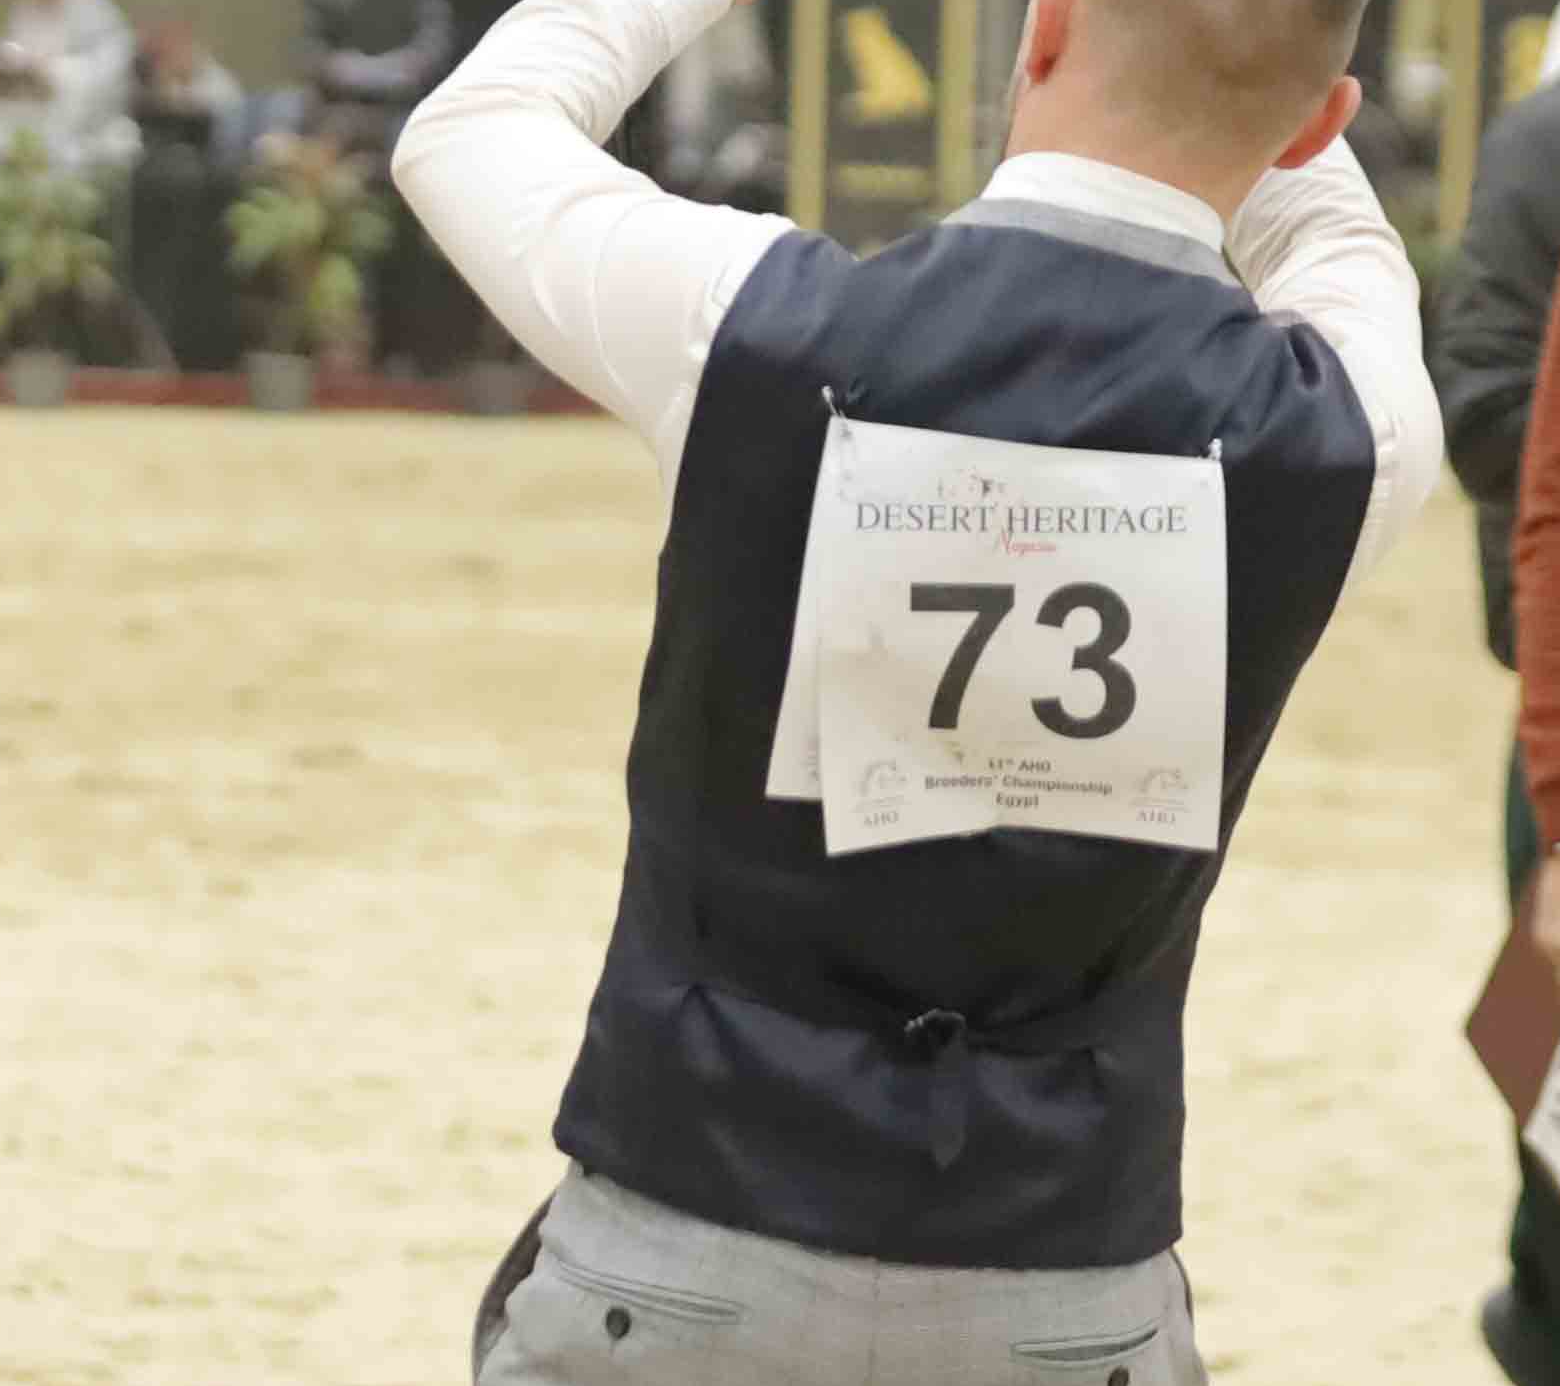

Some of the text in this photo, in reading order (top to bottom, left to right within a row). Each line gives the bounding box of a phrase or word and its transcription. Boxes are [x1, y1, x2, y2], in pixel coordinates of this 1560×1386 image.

[856, 501, 1186, 534] DESERT HERITAGE
[909, 580, 1137, 740] 73
[1017, 759, 1052, 773] AHO
[1001, 774, 1113, 796] Championship
[995, 792, 1040, 809] Egypt
